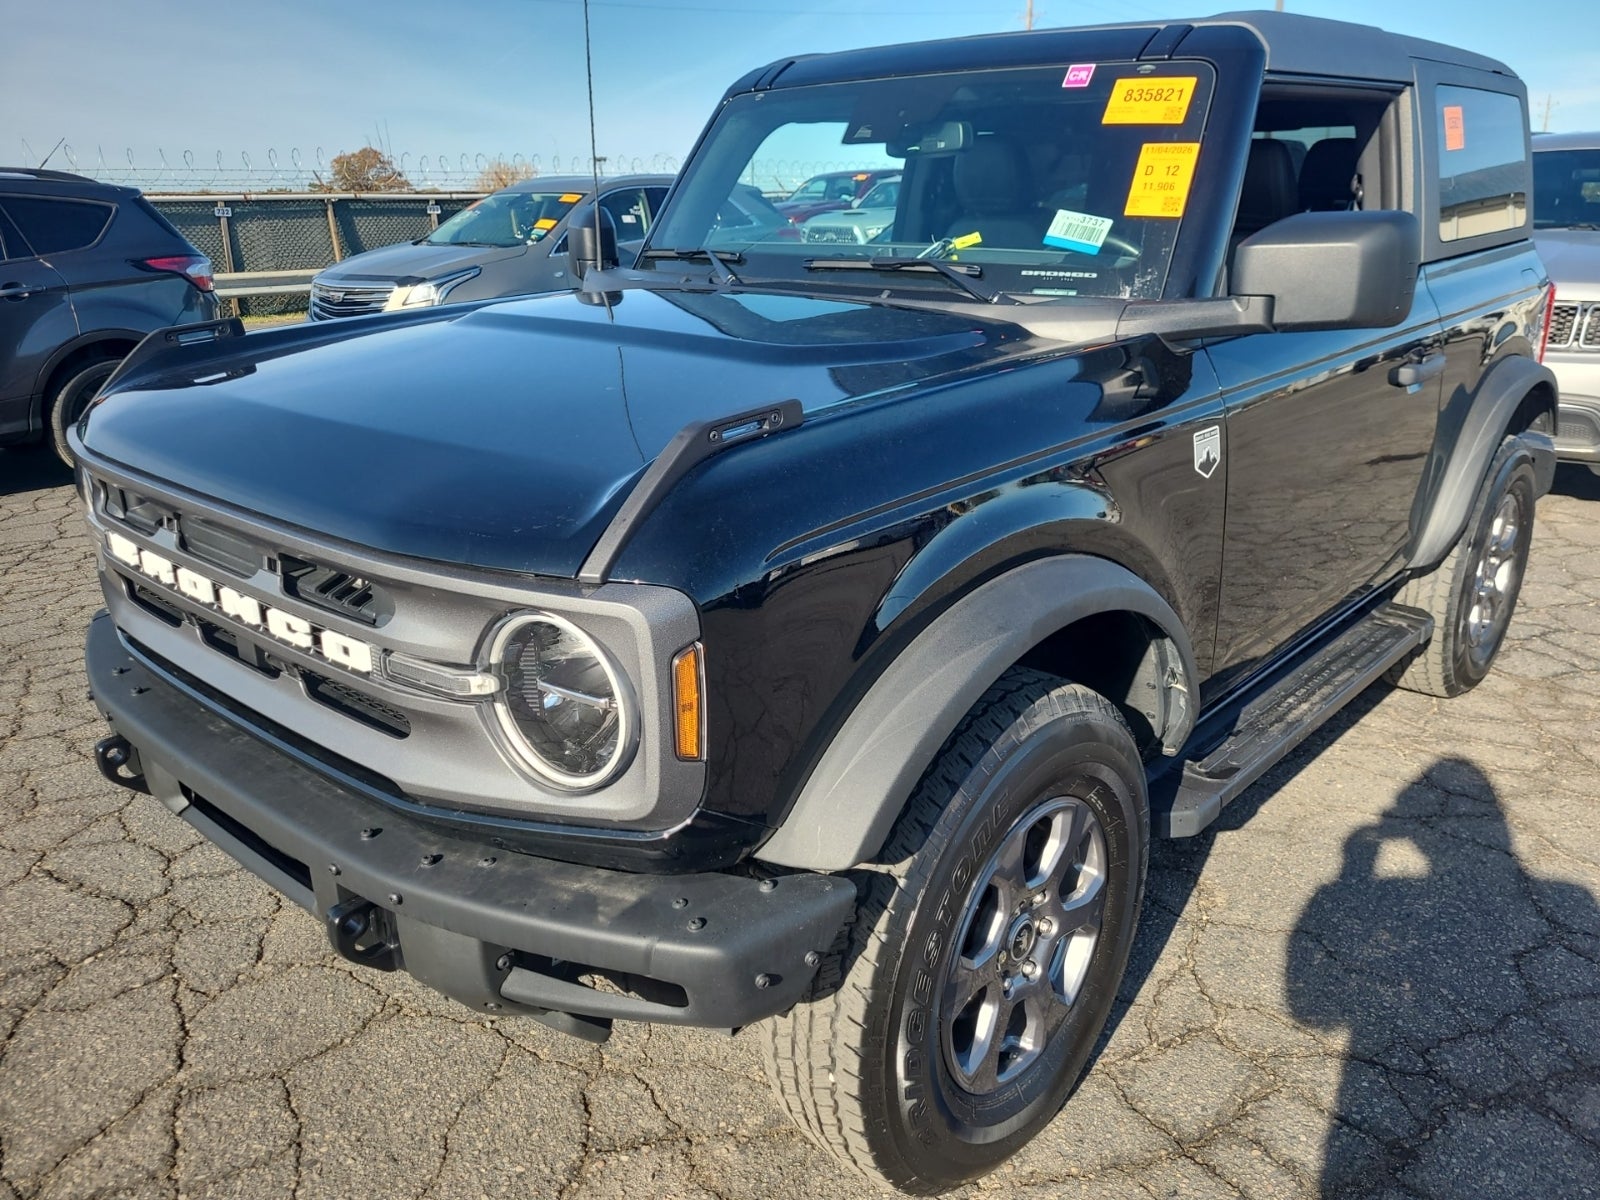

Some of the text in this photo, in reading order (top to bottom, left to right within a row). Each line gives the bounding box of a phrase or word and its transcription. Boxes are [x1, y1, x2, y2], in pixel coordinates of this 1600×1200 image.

[1123, 88, 1184, 102] 835821
[1144, 165, 1180, 176] D 12
[216, 208, 230, 216] 732
[1021, 270, 1098, 279] BRONCO
[107, 530, 373, 673] BRONCO
